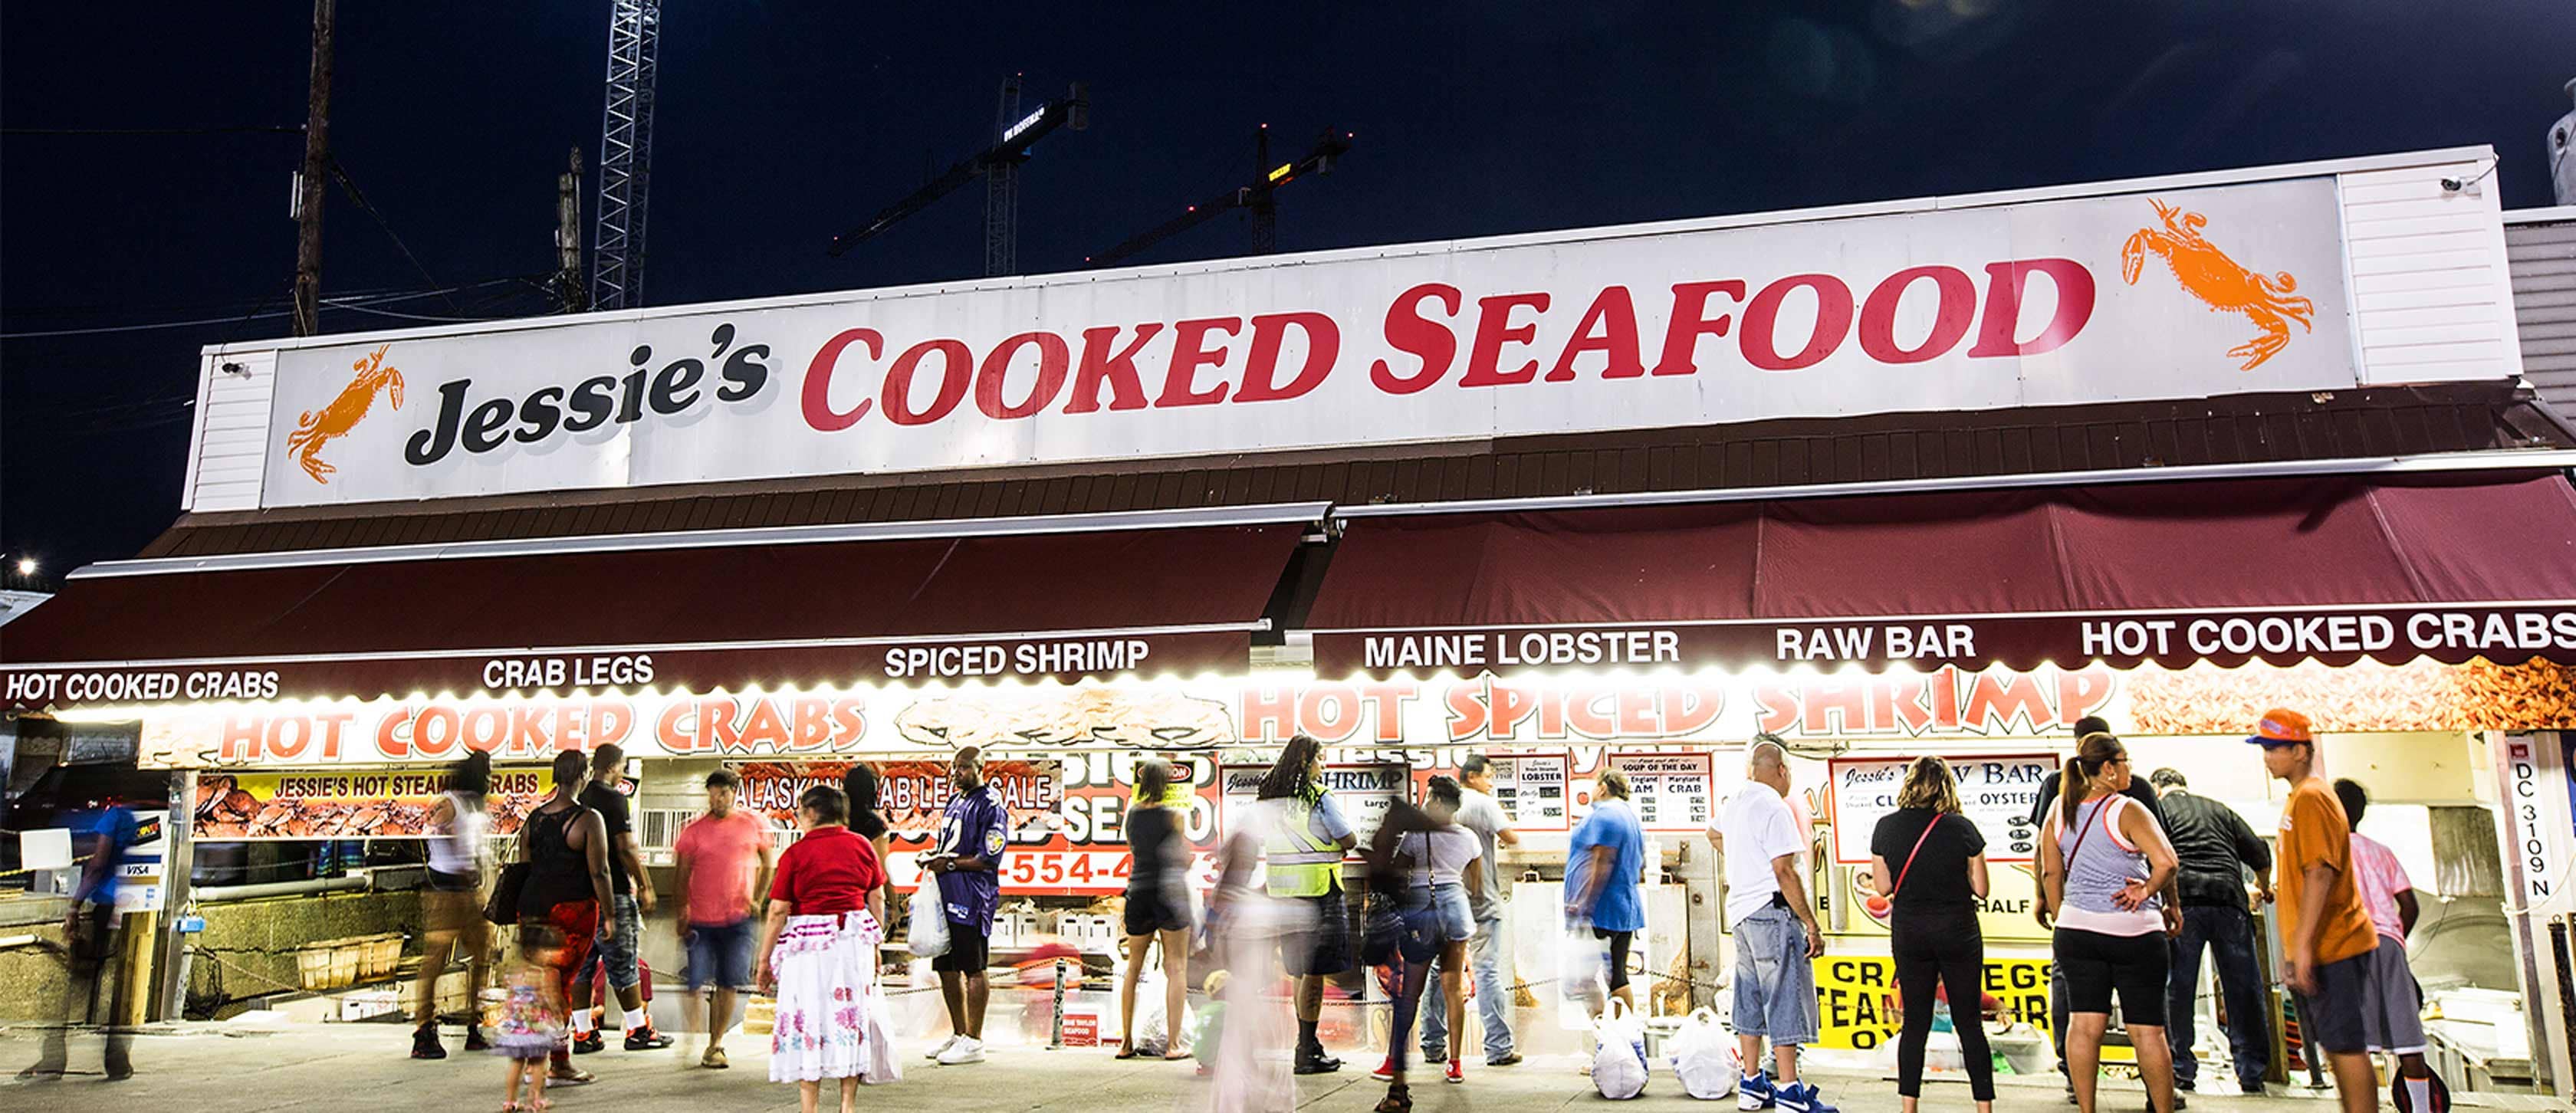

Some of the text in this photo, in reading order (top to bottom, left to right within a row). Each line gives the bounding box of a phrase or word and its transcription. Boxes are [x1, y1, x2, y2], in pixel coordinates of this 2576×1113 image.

[404, 258, 2096, 466] Jessie's COOKED SEAFOOD
[1365, 631, 1680, 668] MAINE LOBSTER
[1776, 625, 1976, 660] RAW BAR
[2083, 613, 2576, 655] HOT COOKED CRABS
[483, 655, 654, 688] CRAB LEGS
[885, 640, 1149, 677] SPICED SHRIMP
[5, 671, 279, 700] HOT COOKED CRABS
[1243, 666, 2113, 740] HOT SPICED SHRIMP
[219, 694, 865, 759] HOT COOKED CRABS
[275, 773, 538, 797] JESSIE'S HOT STEAM RABS
[1318, 771, 1403, 790] HRIMP
[1521, 773, 1562, 781] LOBSTER
[1629, 784, 1654, 793] AM
[1668, 784, 1702, 793] CRAB
[1845, 767, 1894, 788] Jessie's
[1981, 763, 2043, 784] BAR
[2515, 763, 2534, 797] DC
[990, 776, 1051, 809] SALE
[1365, 799, 1390, 809] Large
[2522, 804, 2545, 872] 3109
[127, 865, 150, 875] VISA
[2532, 879, 2549, 896] N
